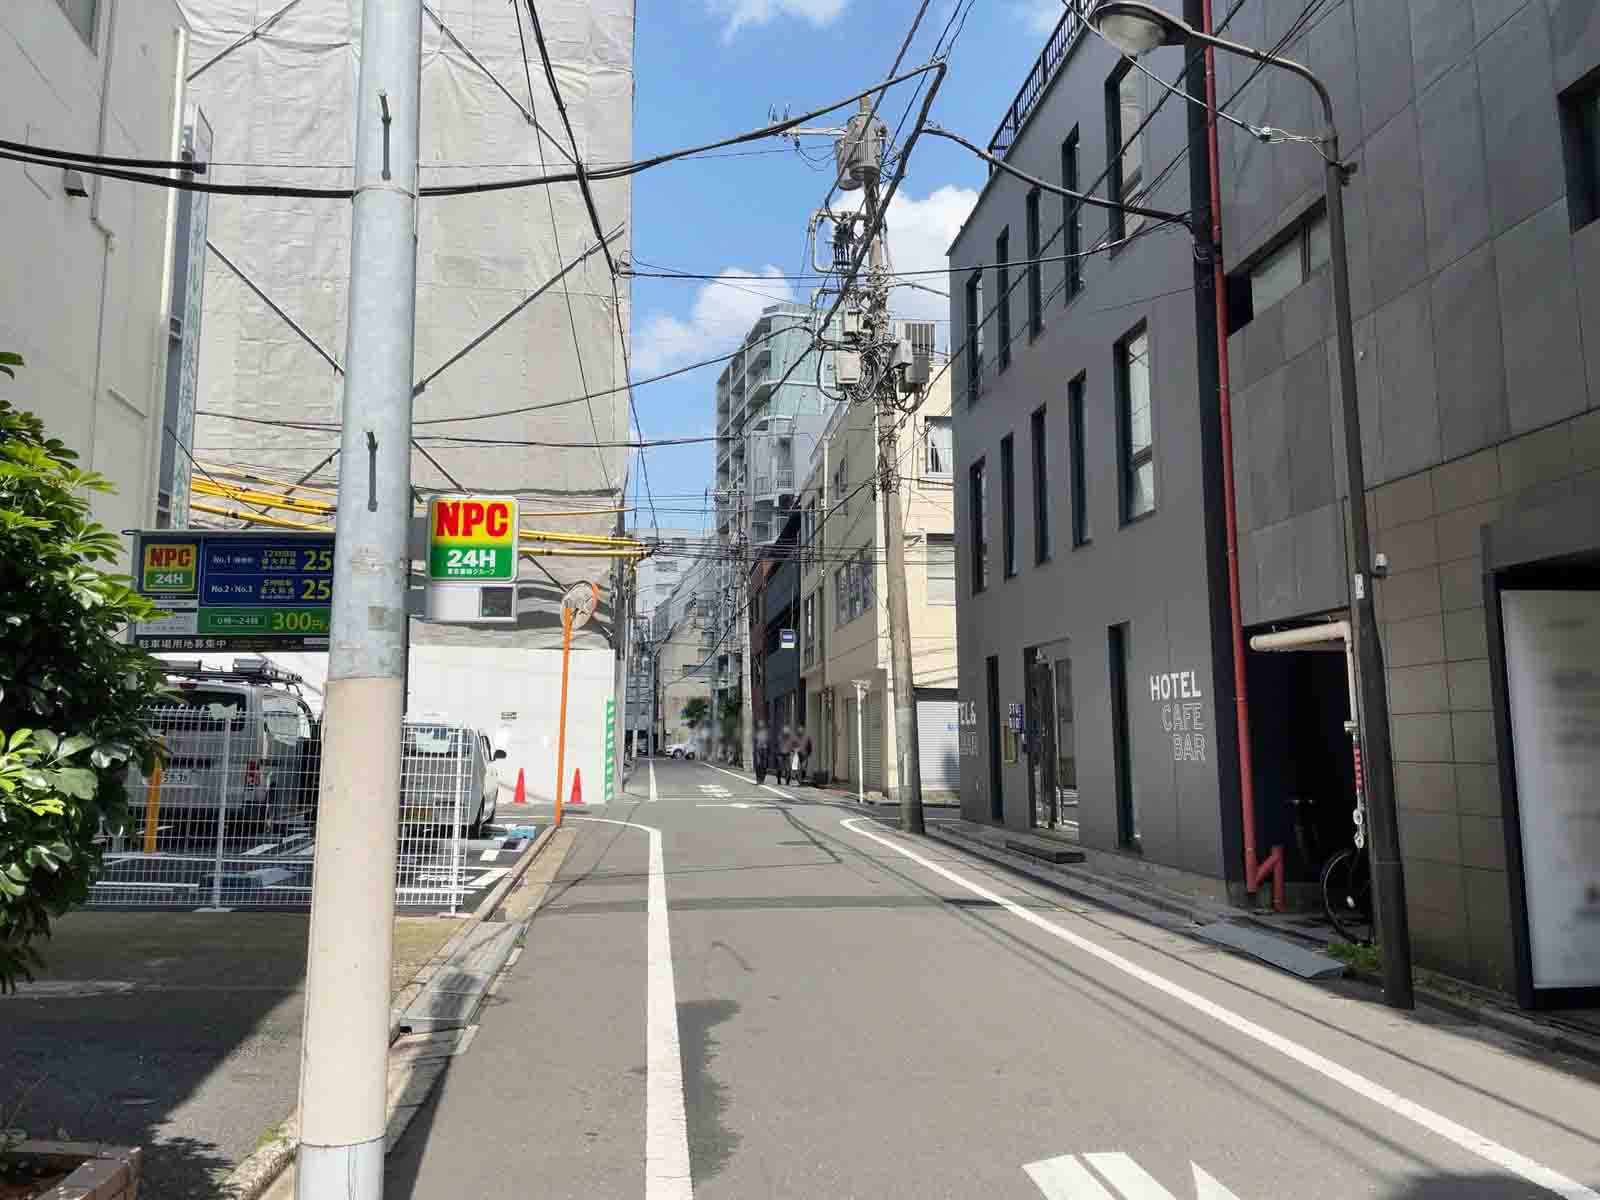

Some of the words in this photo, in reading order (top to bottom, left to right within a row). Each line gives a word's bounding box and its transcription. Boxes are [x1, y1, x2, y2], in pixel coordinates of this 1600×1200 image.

[436, 501, 508, 537] NPC
[150, 548, 192, 567] NPC
[447, 549, 496, 568] 24H
[154, 574, 184, 584] 24H
[1150, 671, 1202, 701] HOTEL
[1161, 702, 1204, 731] CAFE
[1173, 733, 1206, 761] BAR
